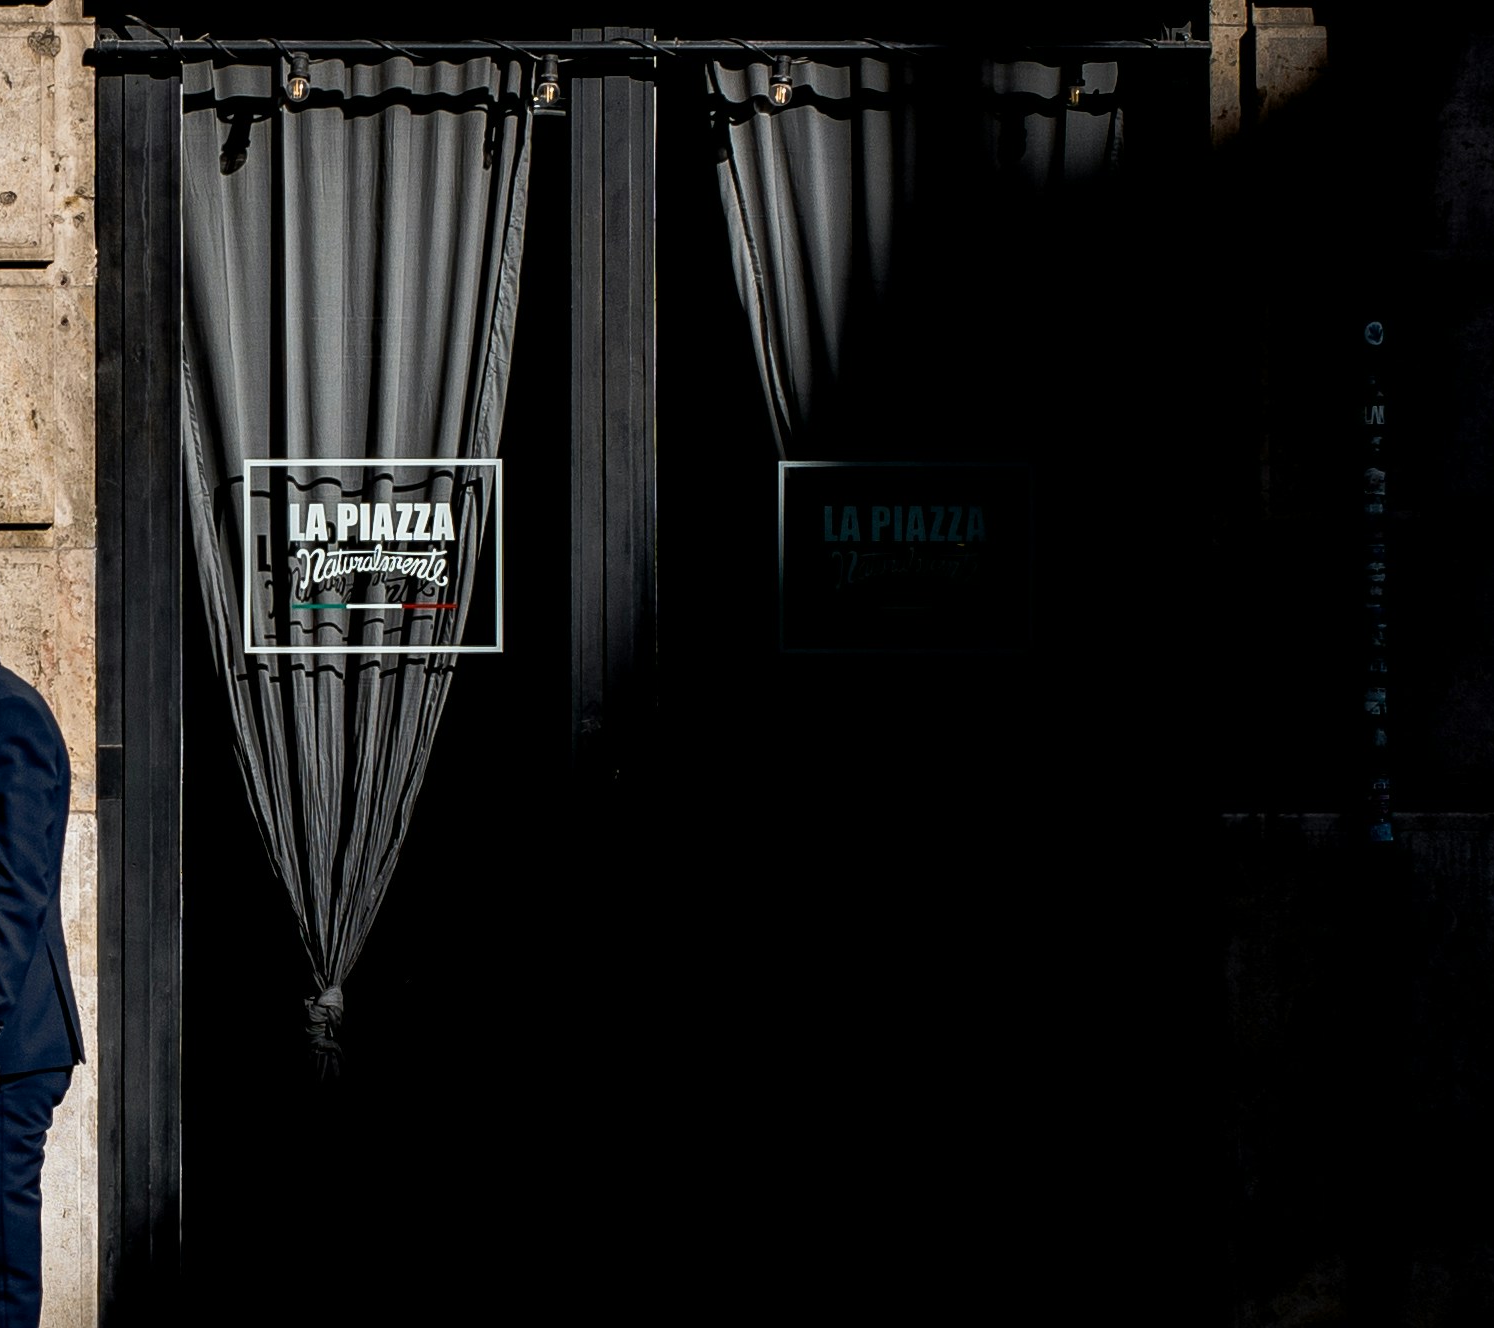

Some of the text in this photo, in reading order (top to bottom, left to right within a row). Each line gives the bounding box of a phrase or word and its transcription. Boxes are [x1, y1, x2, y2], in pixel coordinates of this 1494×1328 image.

[289, 503, 456, 542] LA PIAZZA
[823, 505, 988, 542] LA PIAZZA
[297, 544, 448, 589] Naturalmente
